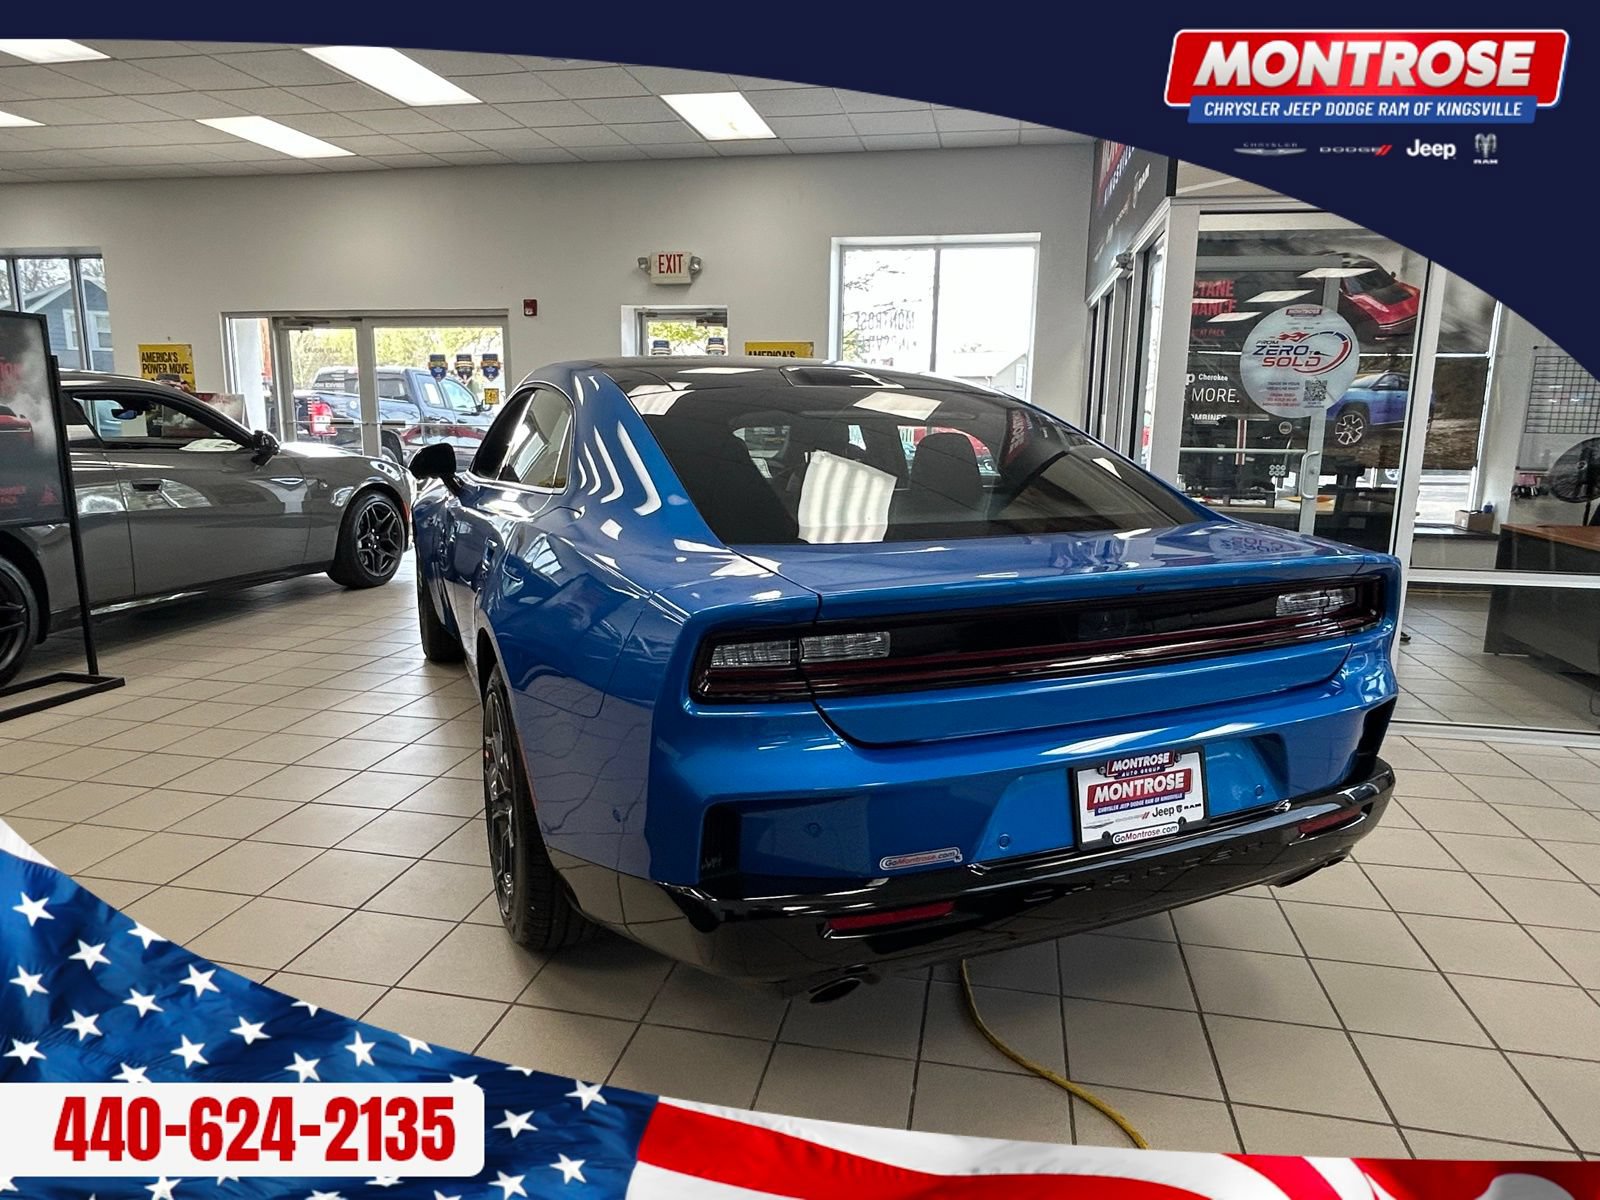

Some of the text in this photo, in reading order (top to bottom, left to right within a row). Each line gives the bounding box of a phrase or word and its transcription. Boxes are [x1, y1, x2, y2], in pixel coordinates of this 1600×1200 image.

[658, 254, 684, 274] EXIT
[1252, 345, 1309, 355] ZERO
[142, 351, 179, 363] AMERICA'S
[1262, 357, 1321, 367] SOLD
[142, 363, 193, 375] POWER MOVE.
[1198, 373, 1229, 382] Cherokee
[1191, 387, 1240, 404] MORE.
[1111, 752, 1170, 772] MONTROSE
[1121, 767, 1161, 778] AUTO GROUP
[1093, 772, 1184, 803] MONTROSE
[1130, 800, 1144, 808] DODGE
[1152, 807, 1175, 818] Jeep
[1114, 824, 1178, 843] GoMontrose.com
[885, 851, 956, 866] GoMontrose.com
